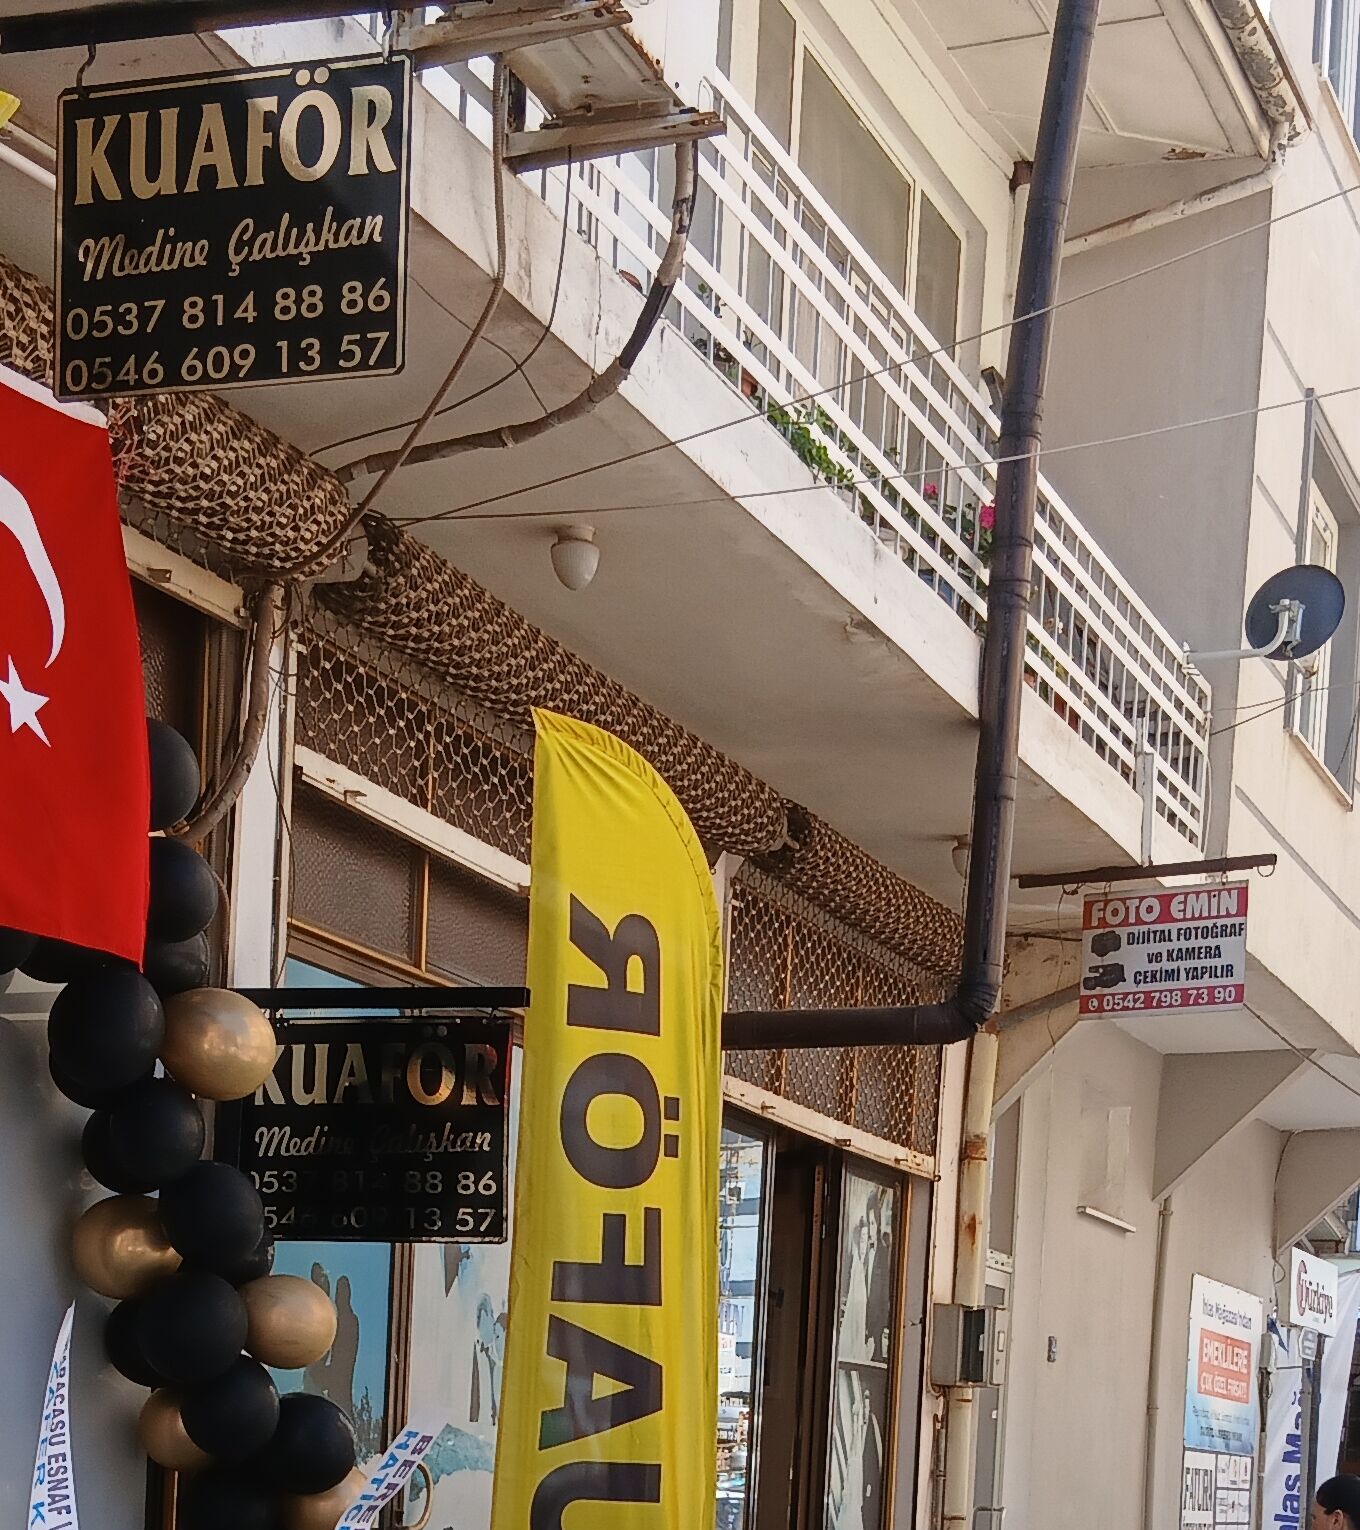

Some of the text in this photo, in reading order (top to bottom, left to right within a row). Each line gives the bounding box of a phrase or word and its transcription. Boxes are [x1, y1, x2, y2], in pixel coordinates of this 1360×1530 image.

[74, 66, 397, 205] KUAFÖR
[78, 205, 384, 282] Medine Çalışkan
[66, 276, 391, 341] 0537 814 88 86
[65, 331, 390, 392] 0546 609 13 57
[1091, 897, 1161, 927] FOTO
[1176, 922, 1245, 942] FOTOĞRAF
[1146, 944, 1222, 964] ve KAMERA
[1133, 964, 1234, 988] ÇEKİMİ YAPILIR
[1103, 986, 1236, 1010] 0542 798 73 90
[404, 1171, 443, 1194] 88
[456, 1170, 497, 1195] 86
[406, 1207, 442, 1231] 13
[455, 1207, 496, 1232] 57
[47, 1452, 72, 1515] ESNAF
